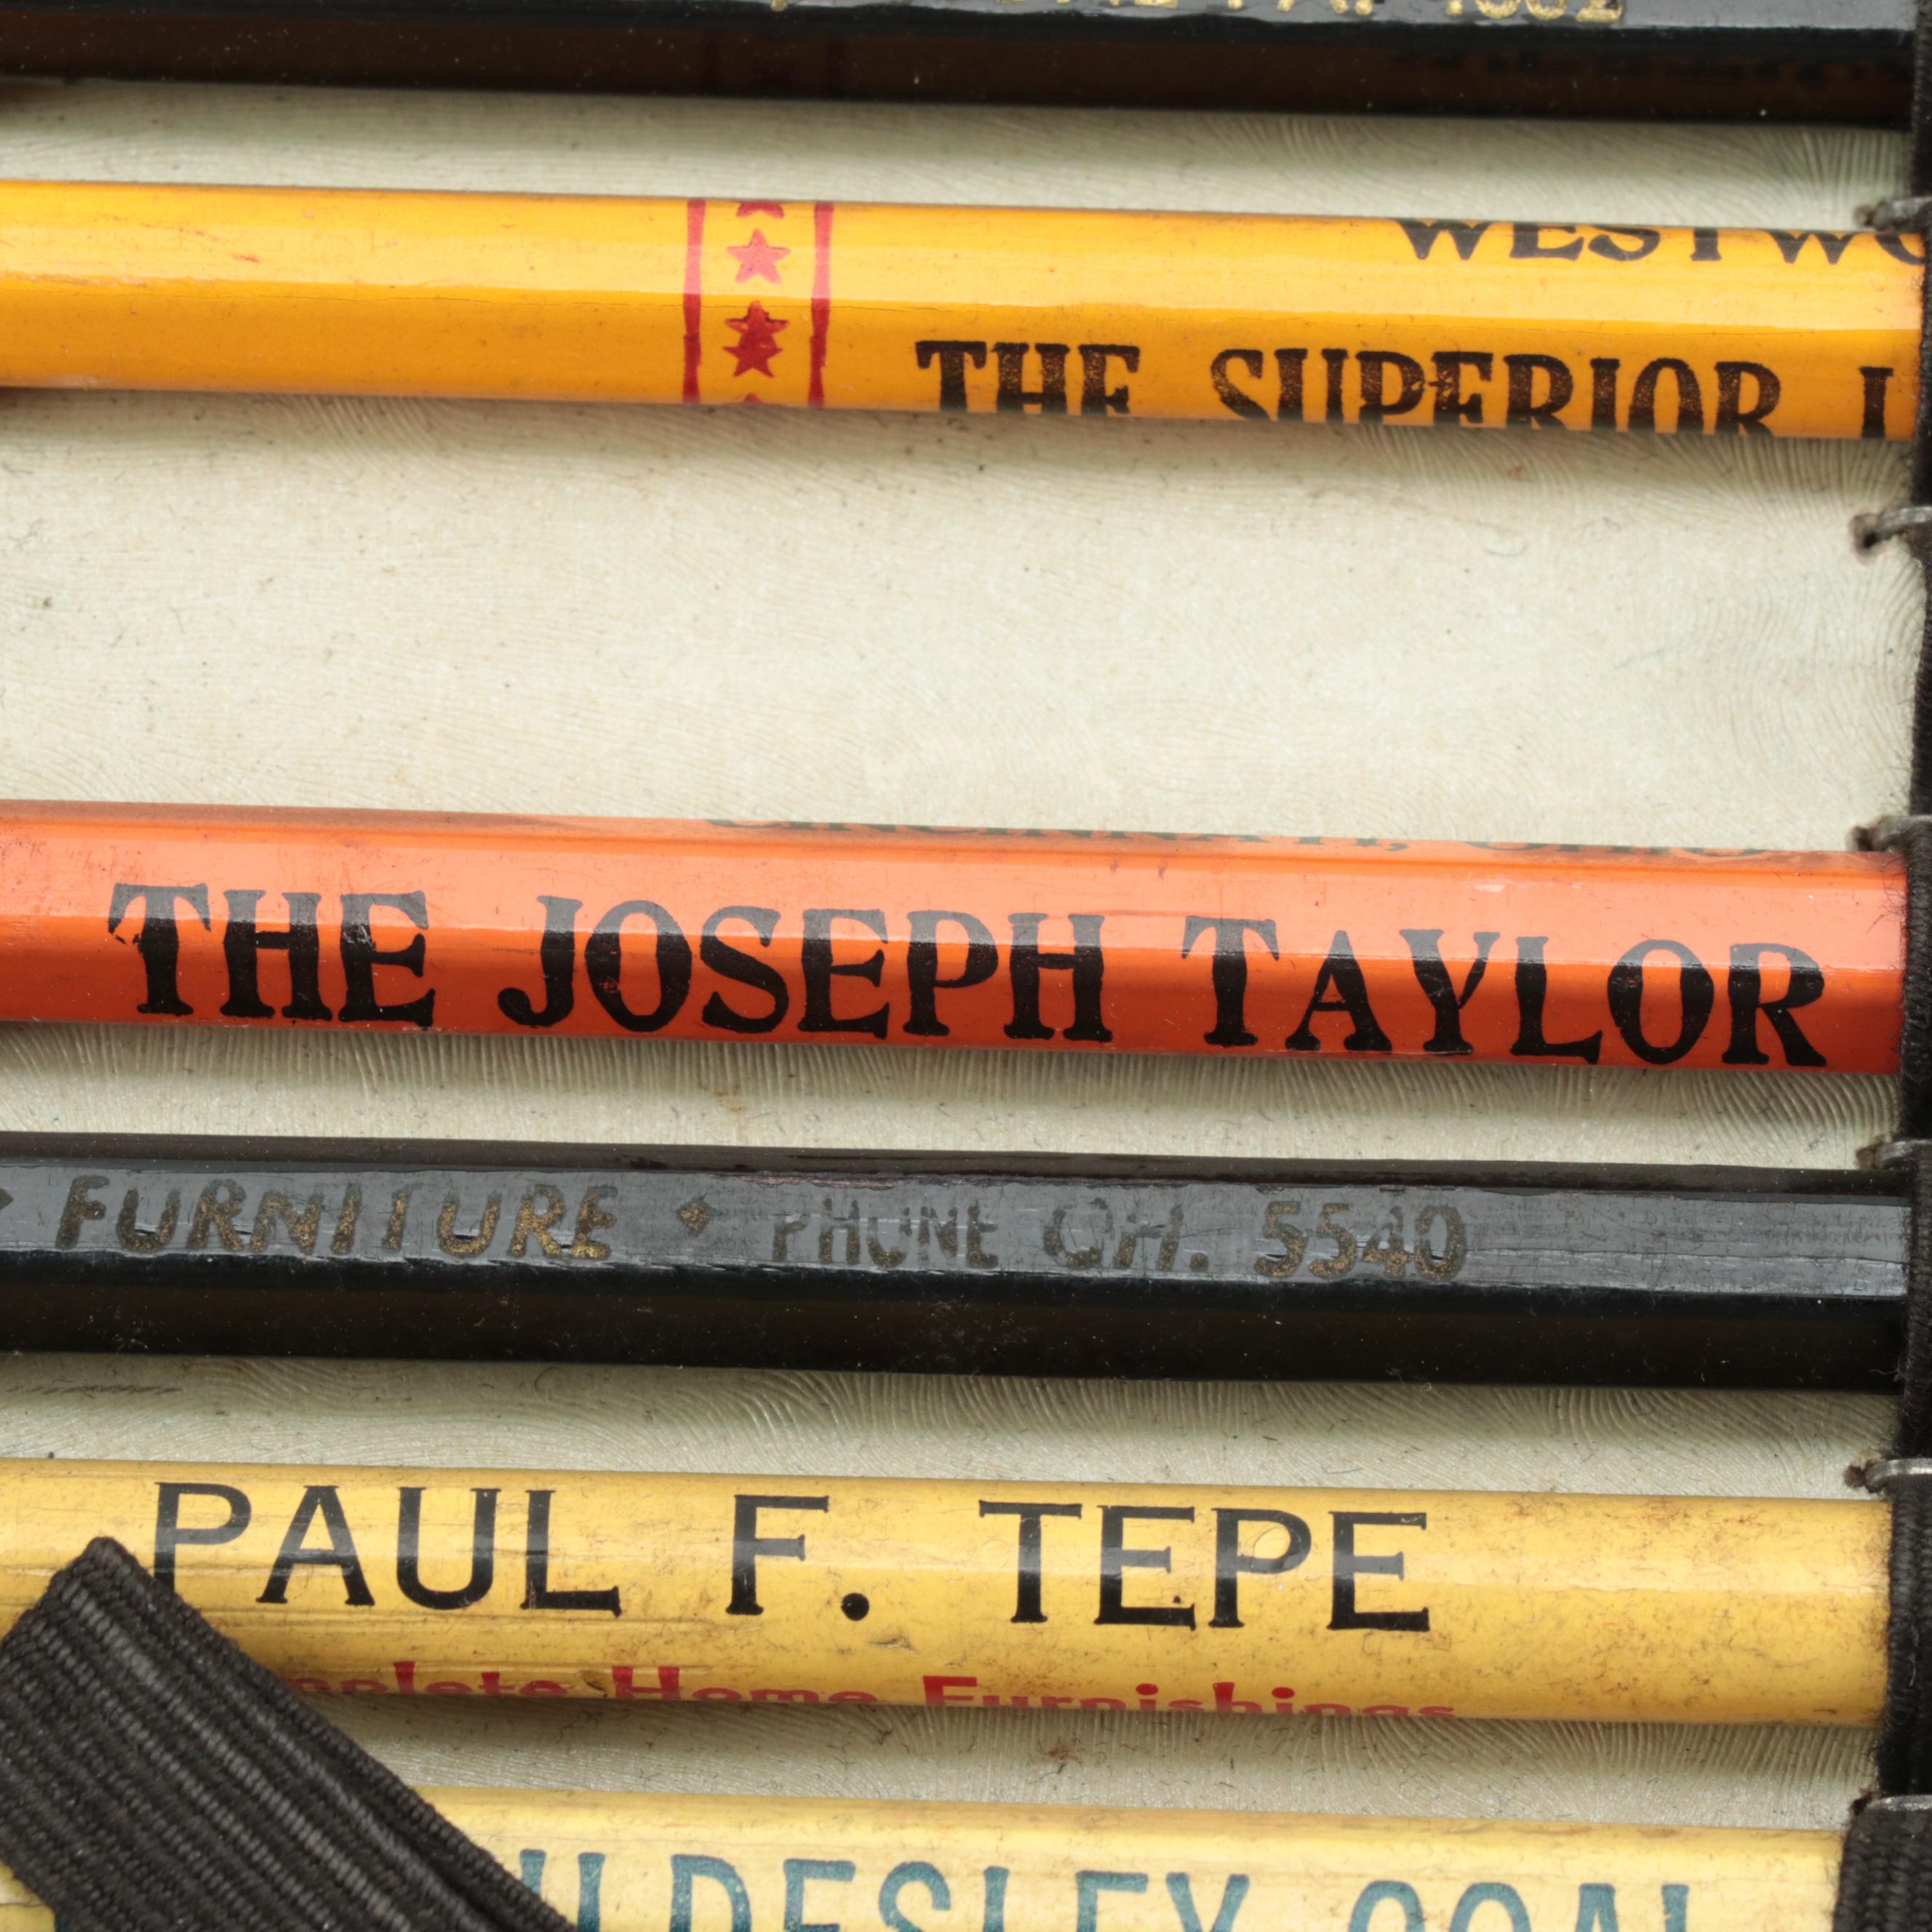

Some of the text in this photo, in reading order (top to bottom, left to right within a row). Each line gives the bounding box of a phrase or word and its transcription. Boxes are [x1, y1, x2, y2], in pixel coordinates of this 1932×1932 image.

[914, 340, 1140, 417] THE
[1210, 348, 1781, 436] SUPERIOR
[107, 883, 1827, 1066] THE JOSEPH TAYLOR
[55, 1174, 620, 1260] FURNITURE
[1253, 1201, 1467, 1282] 5540
[153, 1481, 1431, 1632] PAUL F. TEPE
